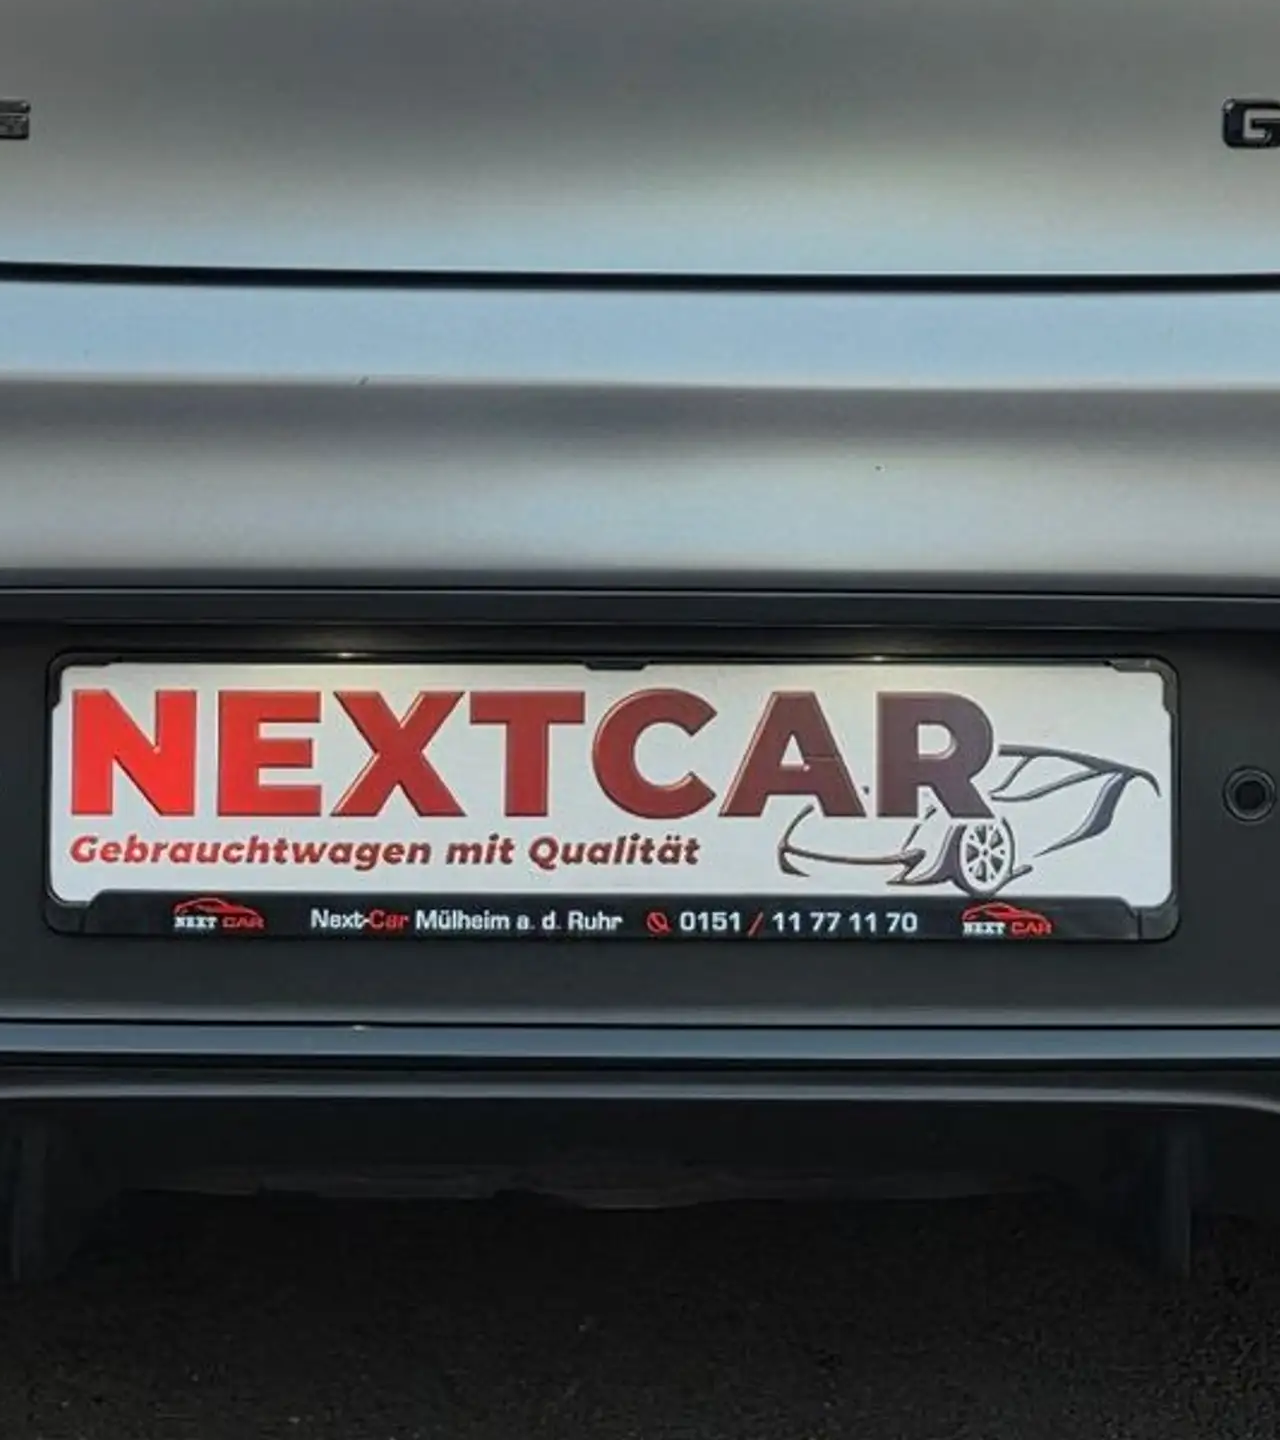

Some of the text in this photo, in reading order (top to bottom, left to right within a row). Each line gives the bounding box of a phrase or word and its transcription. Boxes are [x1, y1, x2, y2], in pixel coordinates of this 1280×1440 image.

[71, 687, 995, 820] NEXTCAR
[69, 833, 701, 871] Gebrauchtwagen mit Qualität
[174, 916, 264, 930] NEXT CAR
[416, 908, 511, 930] Mülheim
[568, 909, 623, 931] Ruhr
[679, 911, 741, 932] 0151
[772, 911, 801, 933] 11
[810, 911, 841, 933] 77
[849, 911, 878, 933] 11
[886, 911, 918, 933] 70
